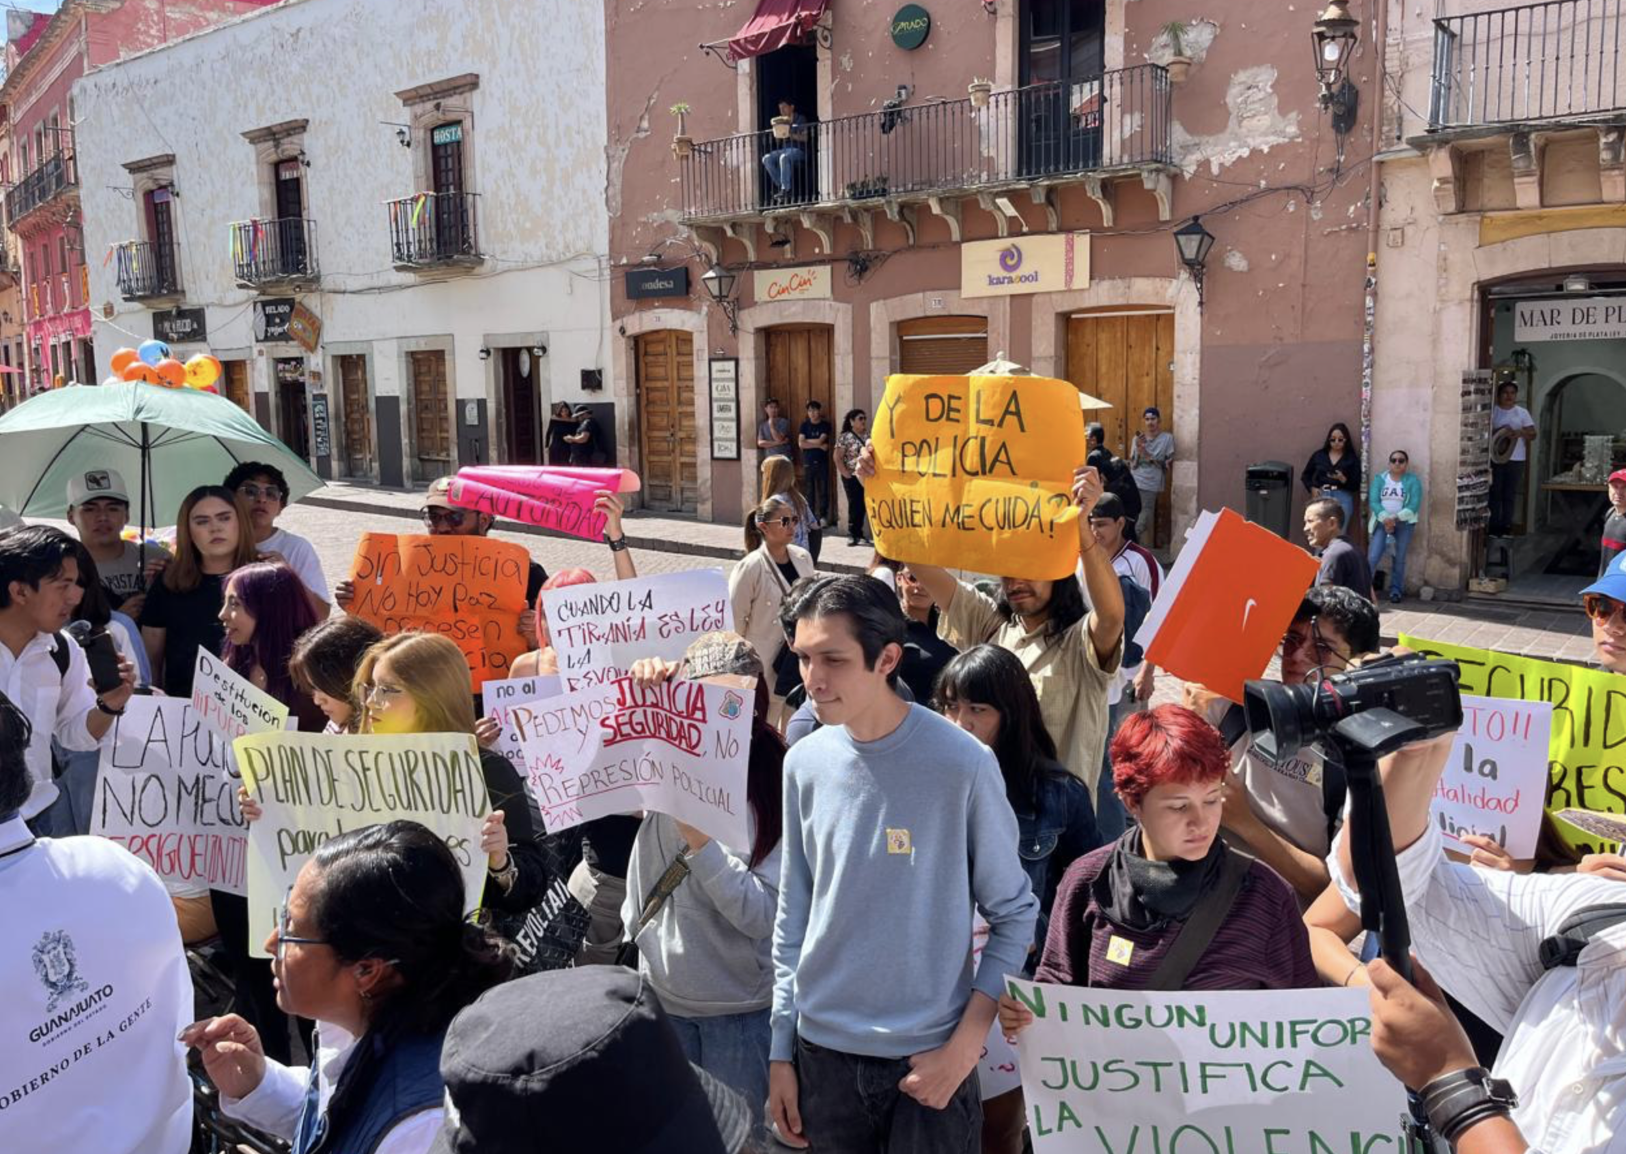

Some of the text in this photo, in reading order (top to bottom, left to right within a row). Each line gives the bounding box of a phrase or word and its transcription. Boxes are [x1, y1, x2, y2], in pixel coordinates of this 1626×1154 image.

[1519, 309, 1561, 327] MAR
[1572, 306, 1597, 325] DE
[885, 389, 1026, 439] Y DE LA
[901, 434, 1018, 478] POLICIA
[941, 503, 975, 531] ME
[413, 541, 522, 585] Justicia
[557, 589, 653, 623] CUANDO LA
[658, 612, 686, 639] ES
[691, 599, 727, 635] LEY
[567, 647, 592, 669] LA
[496, 680, 536, 698] no al
[1464, 743, 1498, 781] la
[102, 774, 168, 829] NO
[28, 983, 114, 1043] GUANAJUATO
[1007, 980, 1207, 1029] NINGUN
[73, 1042, 93, 1062] DE
[97, 1030, 115, 1048] LA
[119, 996, 153, 1033] GENTE
[1039, 1056, 1345, 1095] JUSTIFICA
[1033, 1101, 1083, 1137] LA
